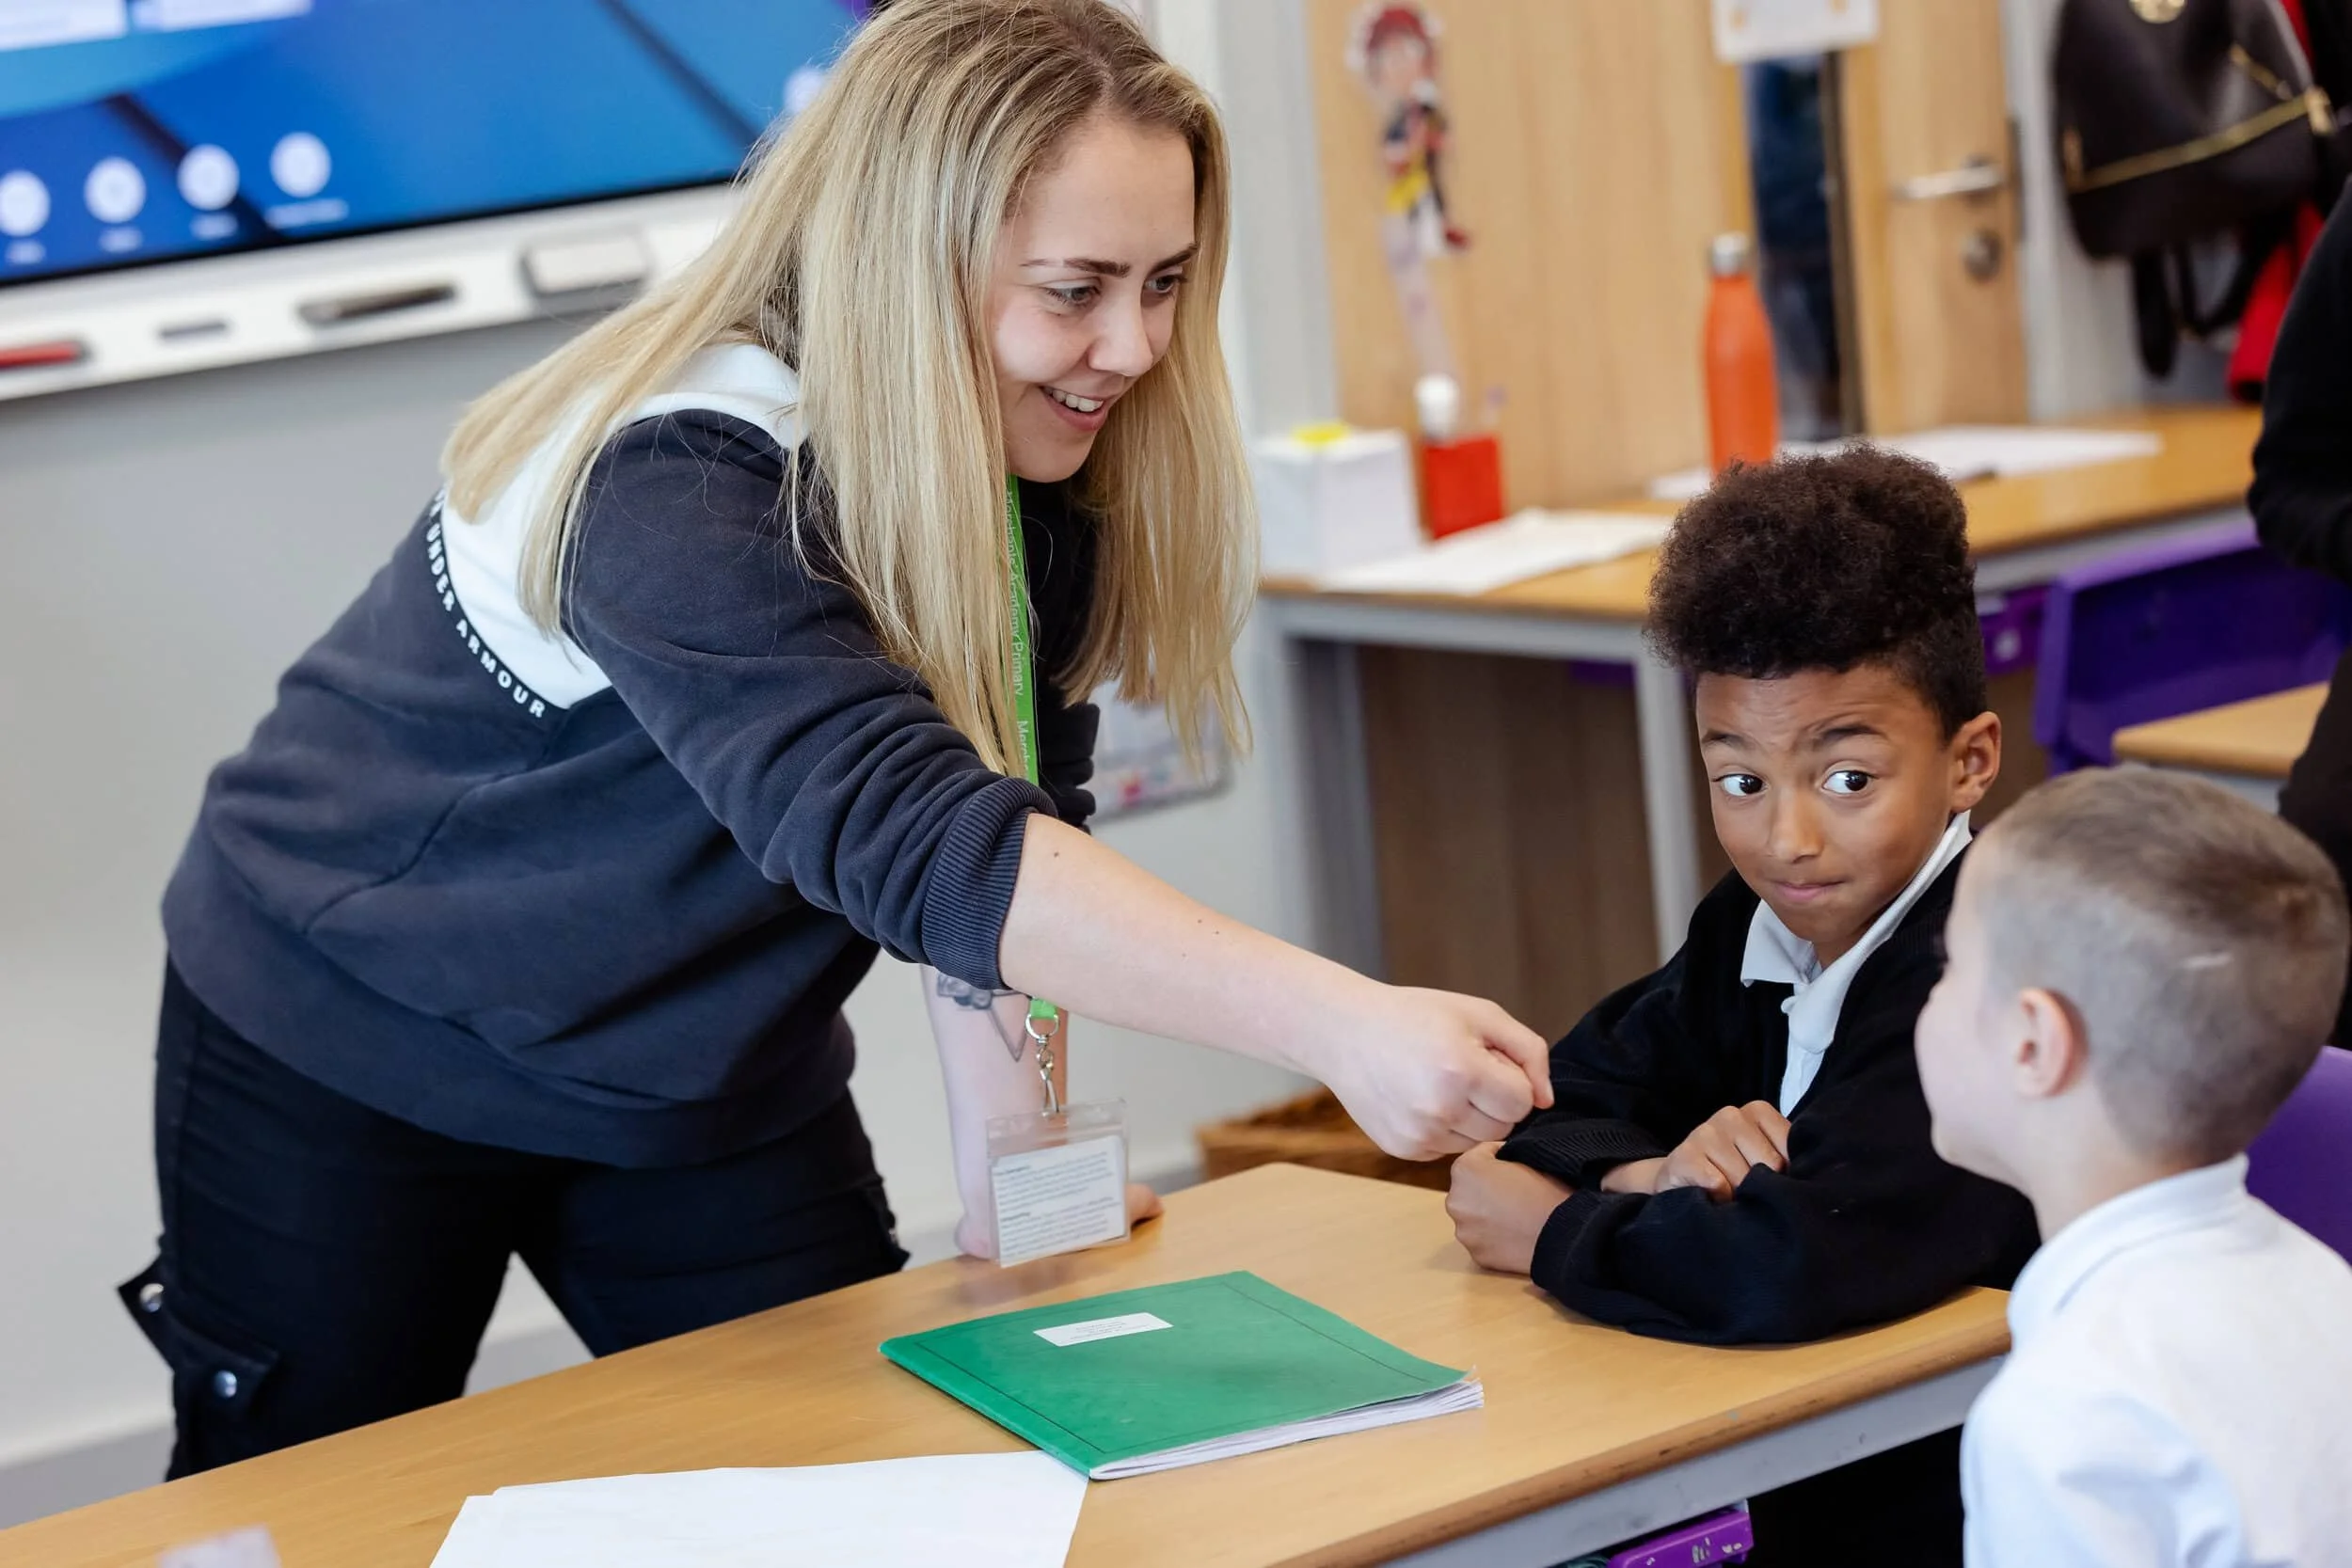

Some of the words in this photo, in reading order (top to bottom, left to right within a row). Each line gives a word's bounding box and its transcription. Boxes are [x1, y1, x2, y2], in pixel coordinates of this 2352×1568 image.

[426, 523, 454, 611] UNDER
[455, 619, 546, 719] ARMOUR
[1011, 641, 1025, 696] Primary
